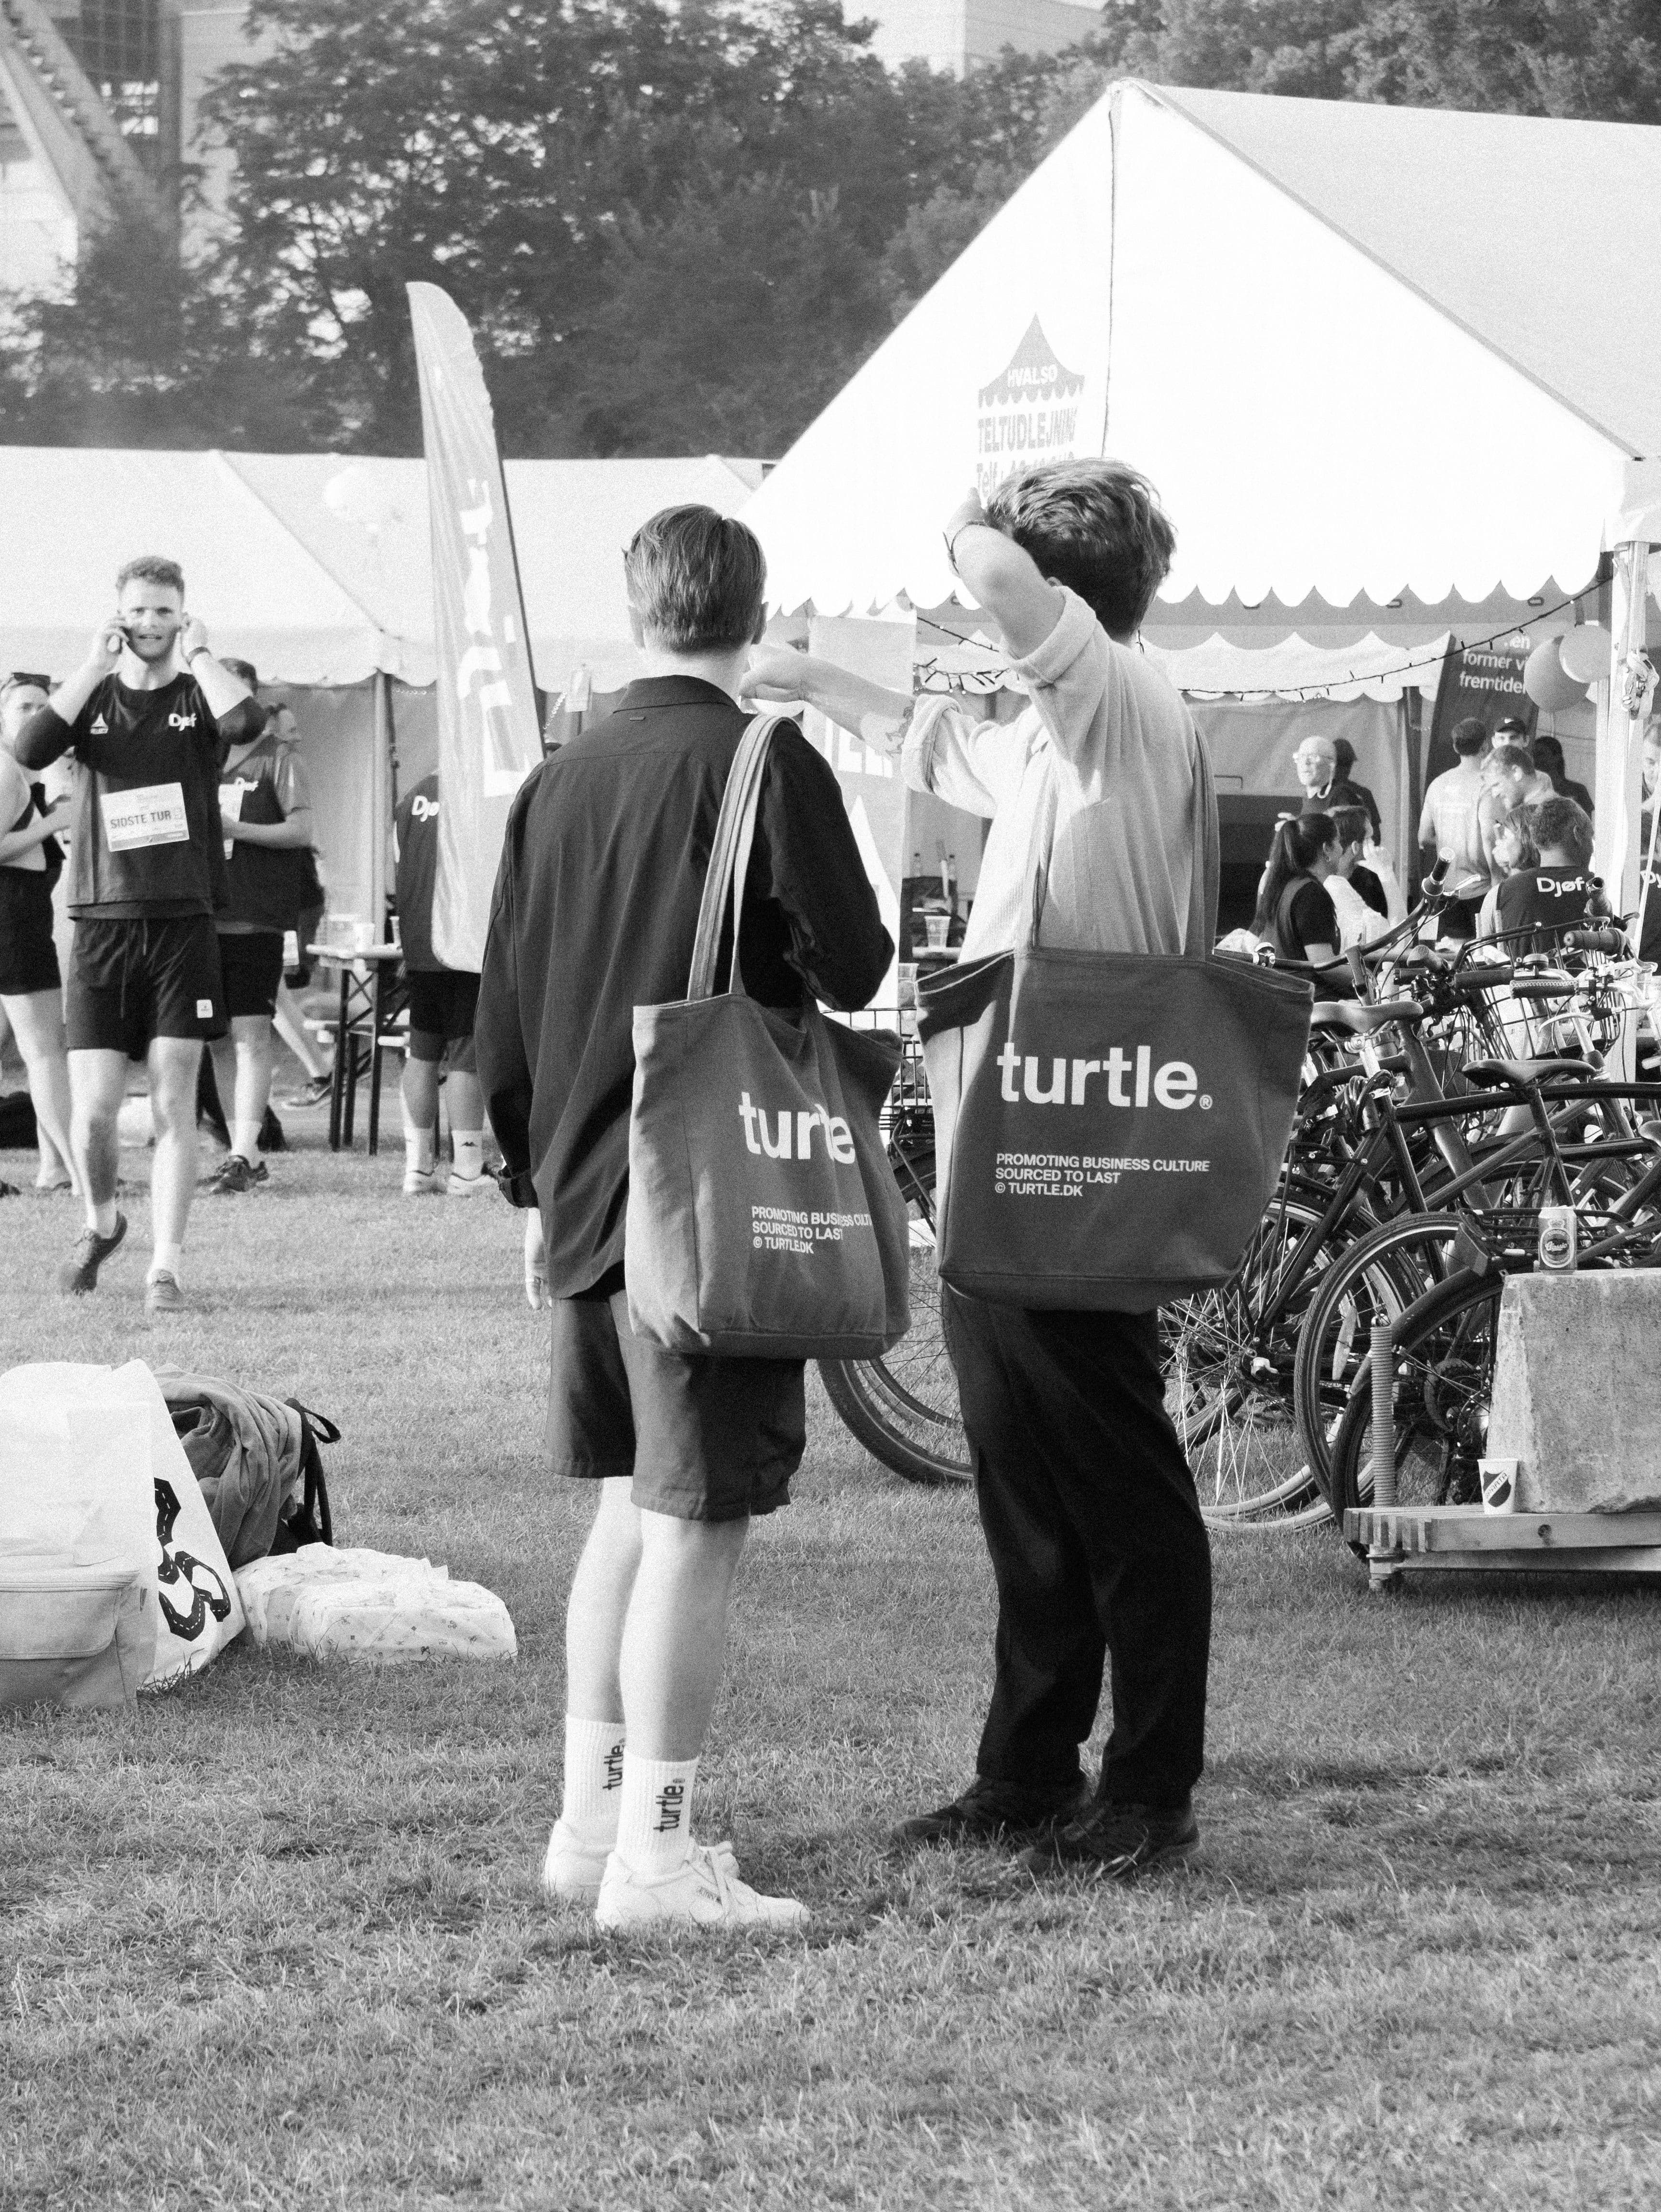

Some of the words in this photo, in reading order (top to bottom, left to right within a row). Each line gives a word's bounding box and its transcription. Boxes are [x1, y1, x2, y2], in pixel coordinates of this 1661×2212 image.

[1463, 648, 1513, 670] former
[110, 814, 147, 829] SIDSTE
[150, 810, 172, 822] TUR
[1536, 876, 1585, 897] Djøf
[997, 1153, 1080, 1168] PROMOTING
[1082, 1157, 1150, 1171] BUSINESS
[1153, 1159, 1211, 1172] CULTURE
[995, 1168, 1061, 1181] SOURCED
[1064, 1170, 1084, 1182] TO
[1086, 1171, 1121, 1184] LAST
[1008, 1182, 1083, 1197] TURTLE.DK
[751, 1205, 808, 1224] PROMOTING
[752, 1221, 797, 1238] SOURCED
[798, 1226, 813, 1239] TO
